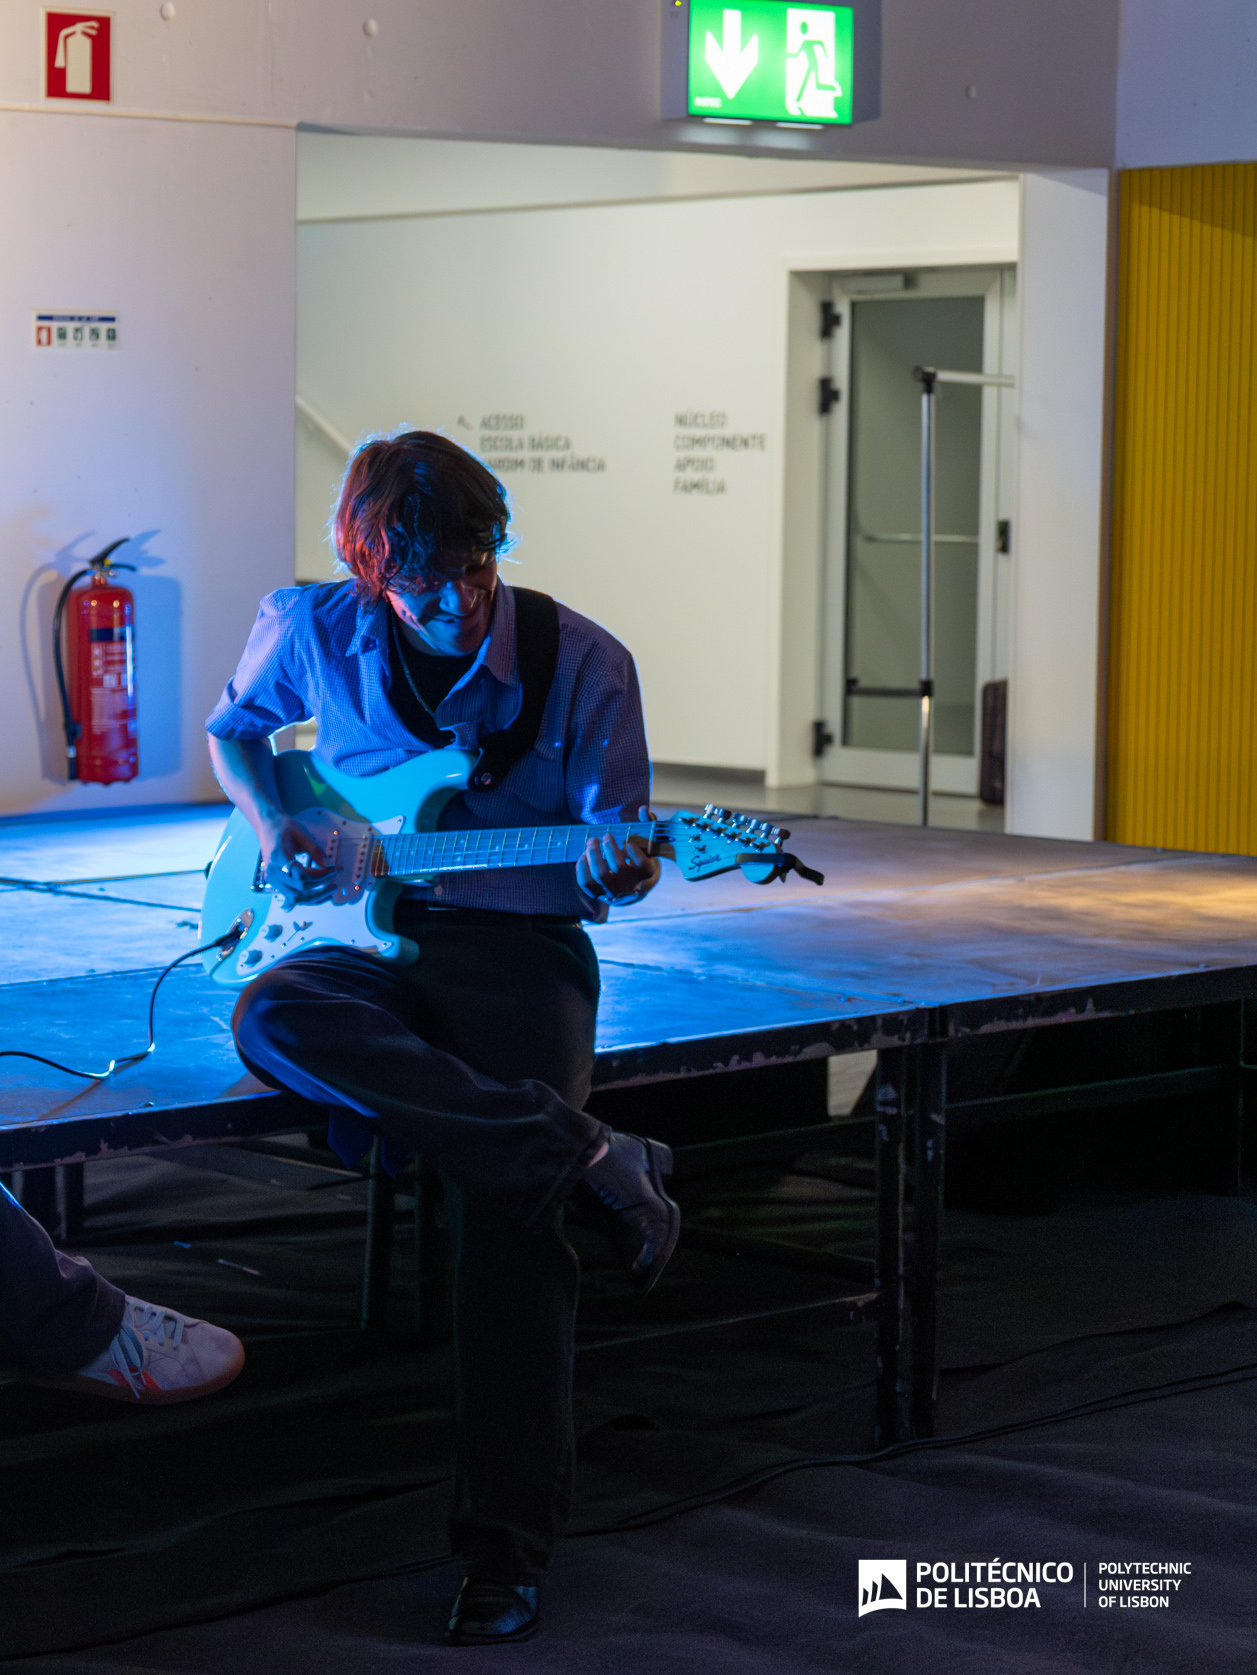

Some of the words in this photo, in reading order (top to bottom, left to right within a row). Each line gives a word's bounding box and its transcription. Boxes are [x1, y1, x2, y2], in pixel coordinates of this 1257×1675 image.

[479, 413, 525, 431] ACESSO
[673, 408, 728, 429] NÚCLEO
[479, 434, 524, 452] ESCOLA
[527, 430, 572, 451] BÁSICA
[673, 432, 767, 452] COMPONENTE
[486, 456, 526, 473] ARDIM
[529, 456, 546, 473] DE
[548, 451, 606, 473] INFÂNCIA
[673, 455, 716, 473] APOIO
[672, 474, 727, 495] FAMÍLIA
[688, 853, 722, 873] Squier
